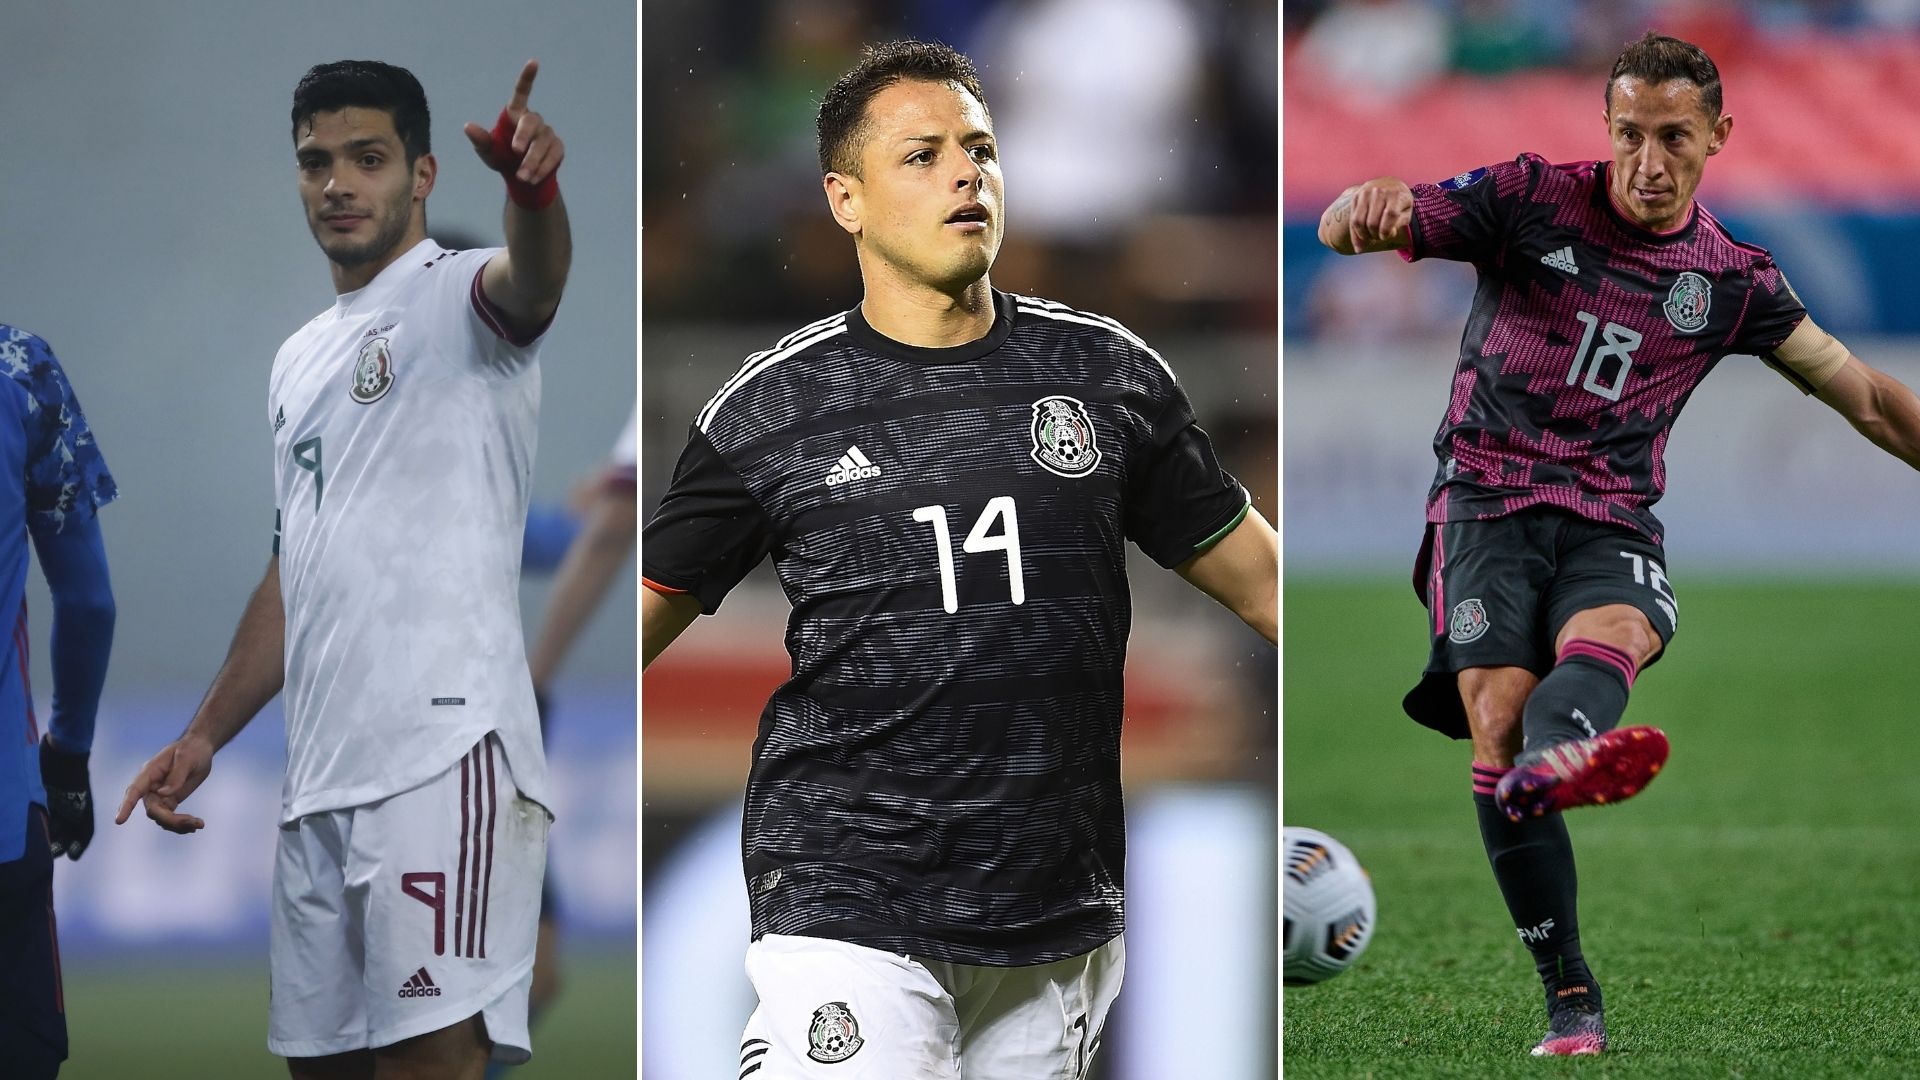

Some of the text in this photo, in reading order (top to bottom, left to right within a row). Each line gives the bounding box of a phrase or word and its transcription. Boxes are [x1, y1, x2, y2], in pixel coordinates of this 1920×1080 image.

[1540, 255, 1580, 275] adidas
[1566, 310, 1644, 402] 18
[293, 436, 323, 516] 9
[825, 465, 882, 487] adidas
[911, 496, 1026, 614] 14
[401, 872, 445, 957] 9
[397, 985, 442, 999] adidas
